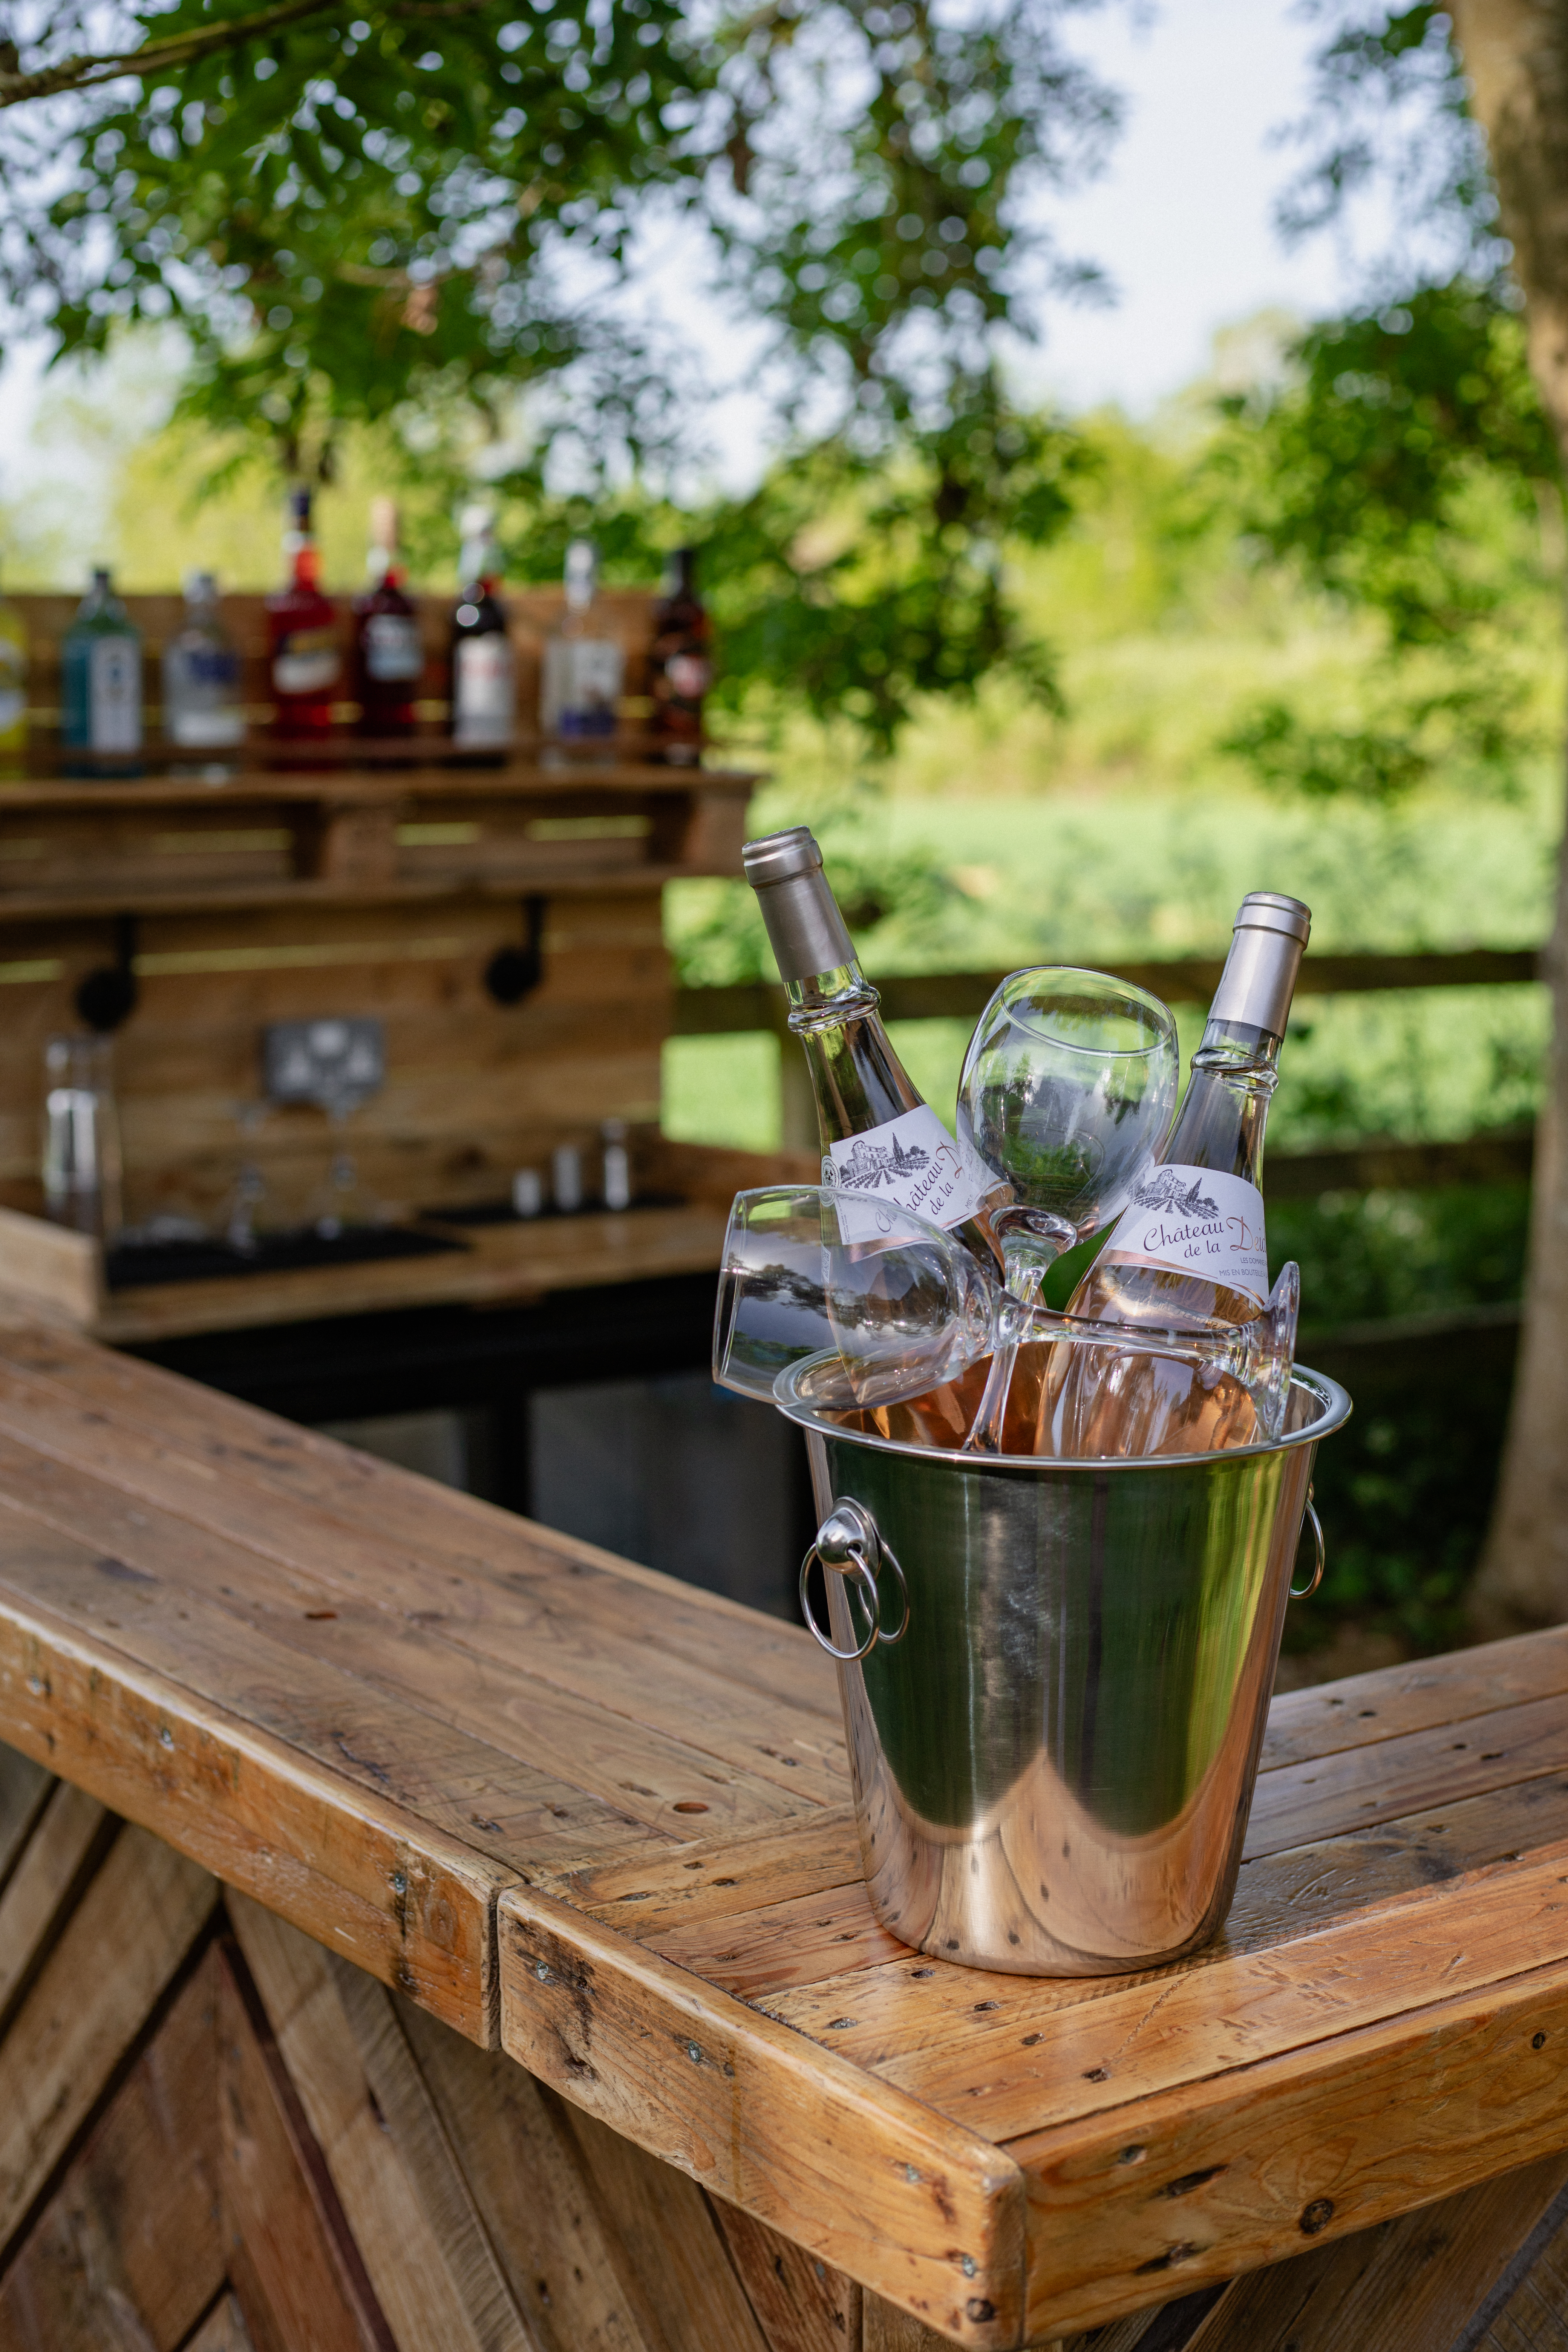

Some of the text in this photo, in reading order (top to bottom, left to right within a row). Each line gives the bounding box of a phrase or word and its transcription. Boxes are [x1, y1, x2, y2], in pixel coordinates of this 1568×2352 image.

[930, 1197, 944, 1215] de
[939, 1182, 954, 1197] la
[1144, 1222, 1224, 1251] Château
[1185, 1244, 1202, 1258] de
[1207, 1240, 1221, 1253] la
